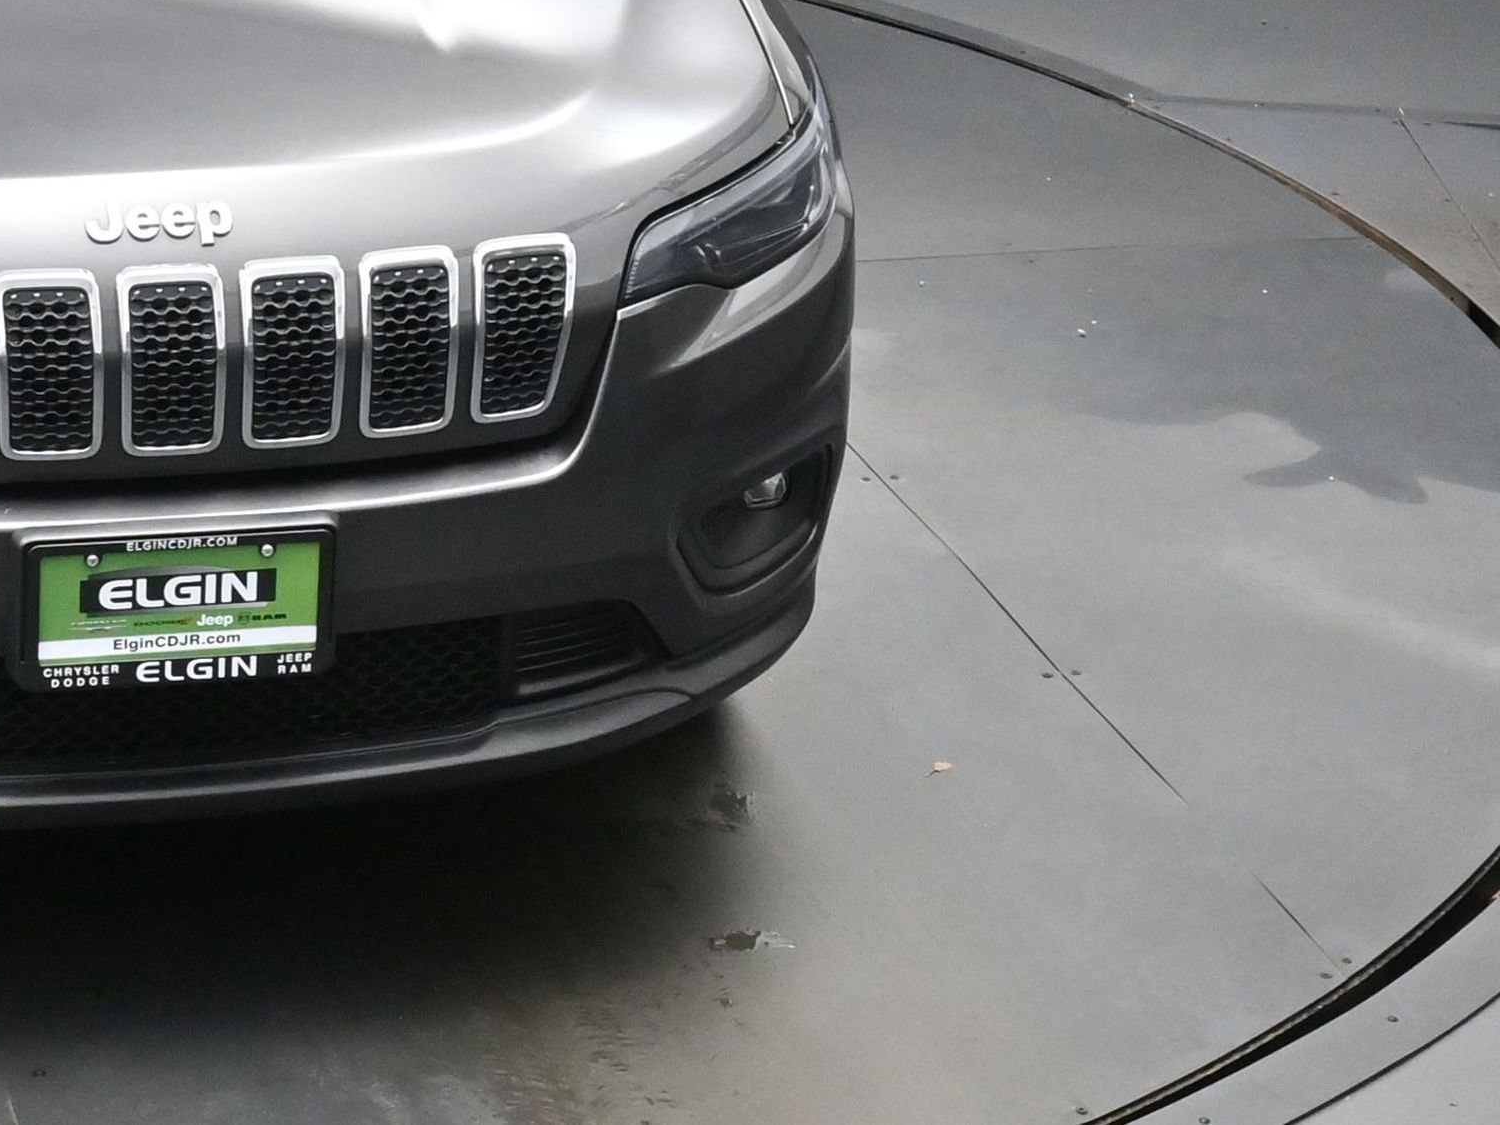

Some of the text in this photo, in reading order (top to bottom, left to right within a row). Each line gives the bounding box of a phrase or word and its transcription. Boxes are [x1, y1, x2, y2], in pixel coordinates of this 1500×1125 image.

[84, 199, 234, 247] Jeep
[126, 536, 238, 552] ELGINCDJR.COM
[98, 571, 258, 610] ELGIN
[196, 613, 234, 627] Jeep
[113, 632, 241, 652] ElginCDJR.com
[277, 652, 312, 663] JEEP
[43, 664, 120, 678] CHRYSLER
[135, 655, 258, 683] ELGIN
[277, 663, 312, 674] RAM
[50, 676, 110, 688] DODGE
